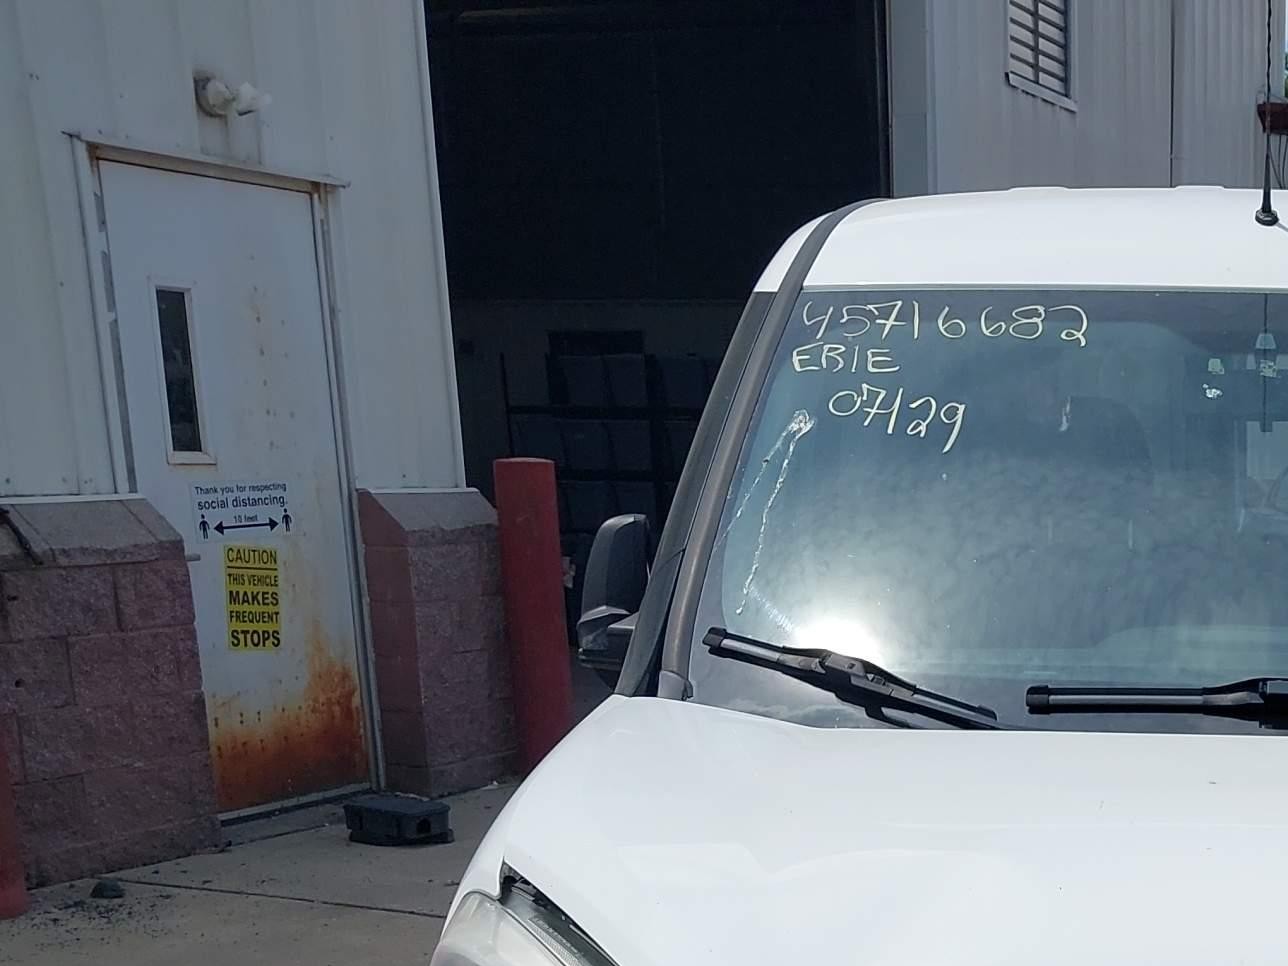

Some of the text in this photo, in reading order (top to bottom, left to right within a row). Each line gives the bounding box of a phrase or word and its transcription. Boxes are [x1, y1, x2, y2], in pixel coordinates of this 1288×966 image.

[802, 299, 1089, 348] 45716682
[194, 483, 287, 496] Thank you for respecting
[197, 494, 288, 511] social distancing.
[226, 547, 278, 565] CAUTION
[227, 572, 279, 588] THIS VEHICLE
[228, 590, 279, 607] MAKES
[229, 610, 280, 625] FREQUENT
[230, 629, 281, 648] STOPS
